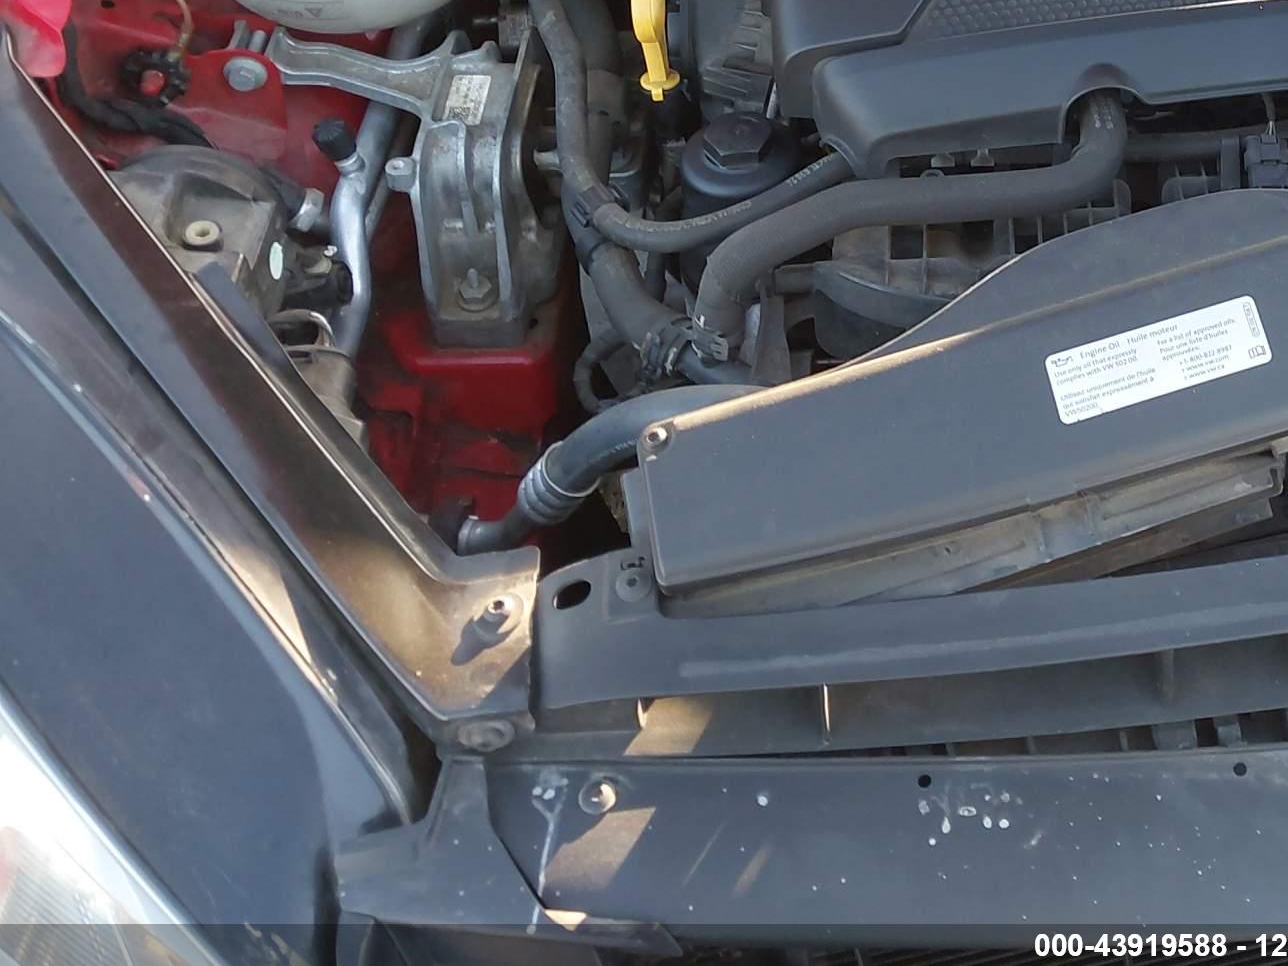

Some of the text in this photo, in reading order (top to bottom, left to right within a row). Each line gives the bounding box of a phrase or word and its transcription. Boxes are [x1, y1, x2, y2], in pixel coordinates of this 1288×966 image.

[1126, 324, 1177, 344] Huile moteur
[1079, 340, 1120, 359] Engine Oil
[1067, 365, 1081, 373] only
[1092, 357, 1106, 366] that
[1086, 366, 1101, 376] with
